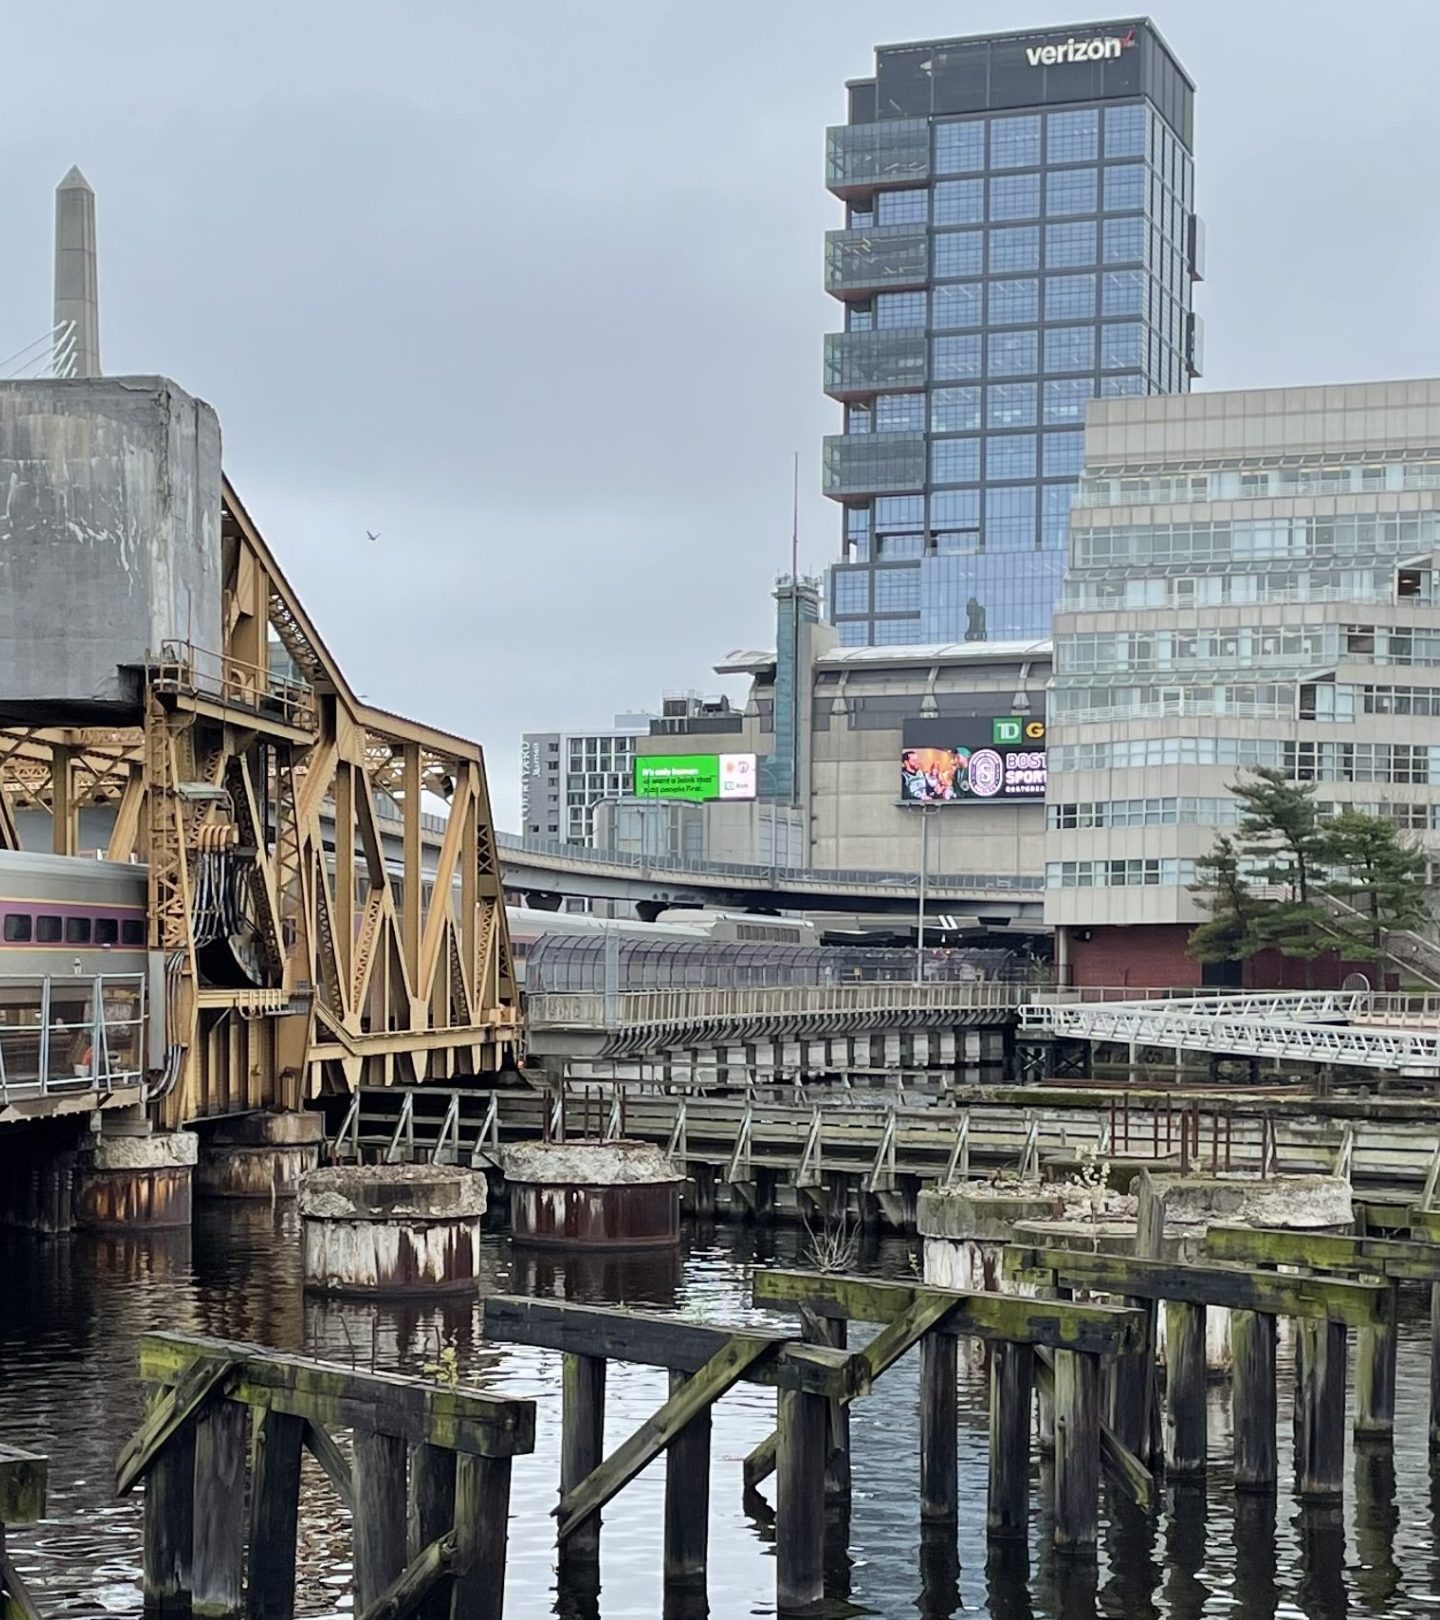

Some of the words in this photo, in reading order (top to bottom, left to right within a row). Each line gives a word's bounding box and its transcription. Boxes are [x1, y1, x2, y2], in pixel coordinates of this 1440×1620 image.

[1026, 38, 1121, 66] verizon
[996, 723, 1019, 739] TD
[521, 741, 530, 820] COURTYARD
